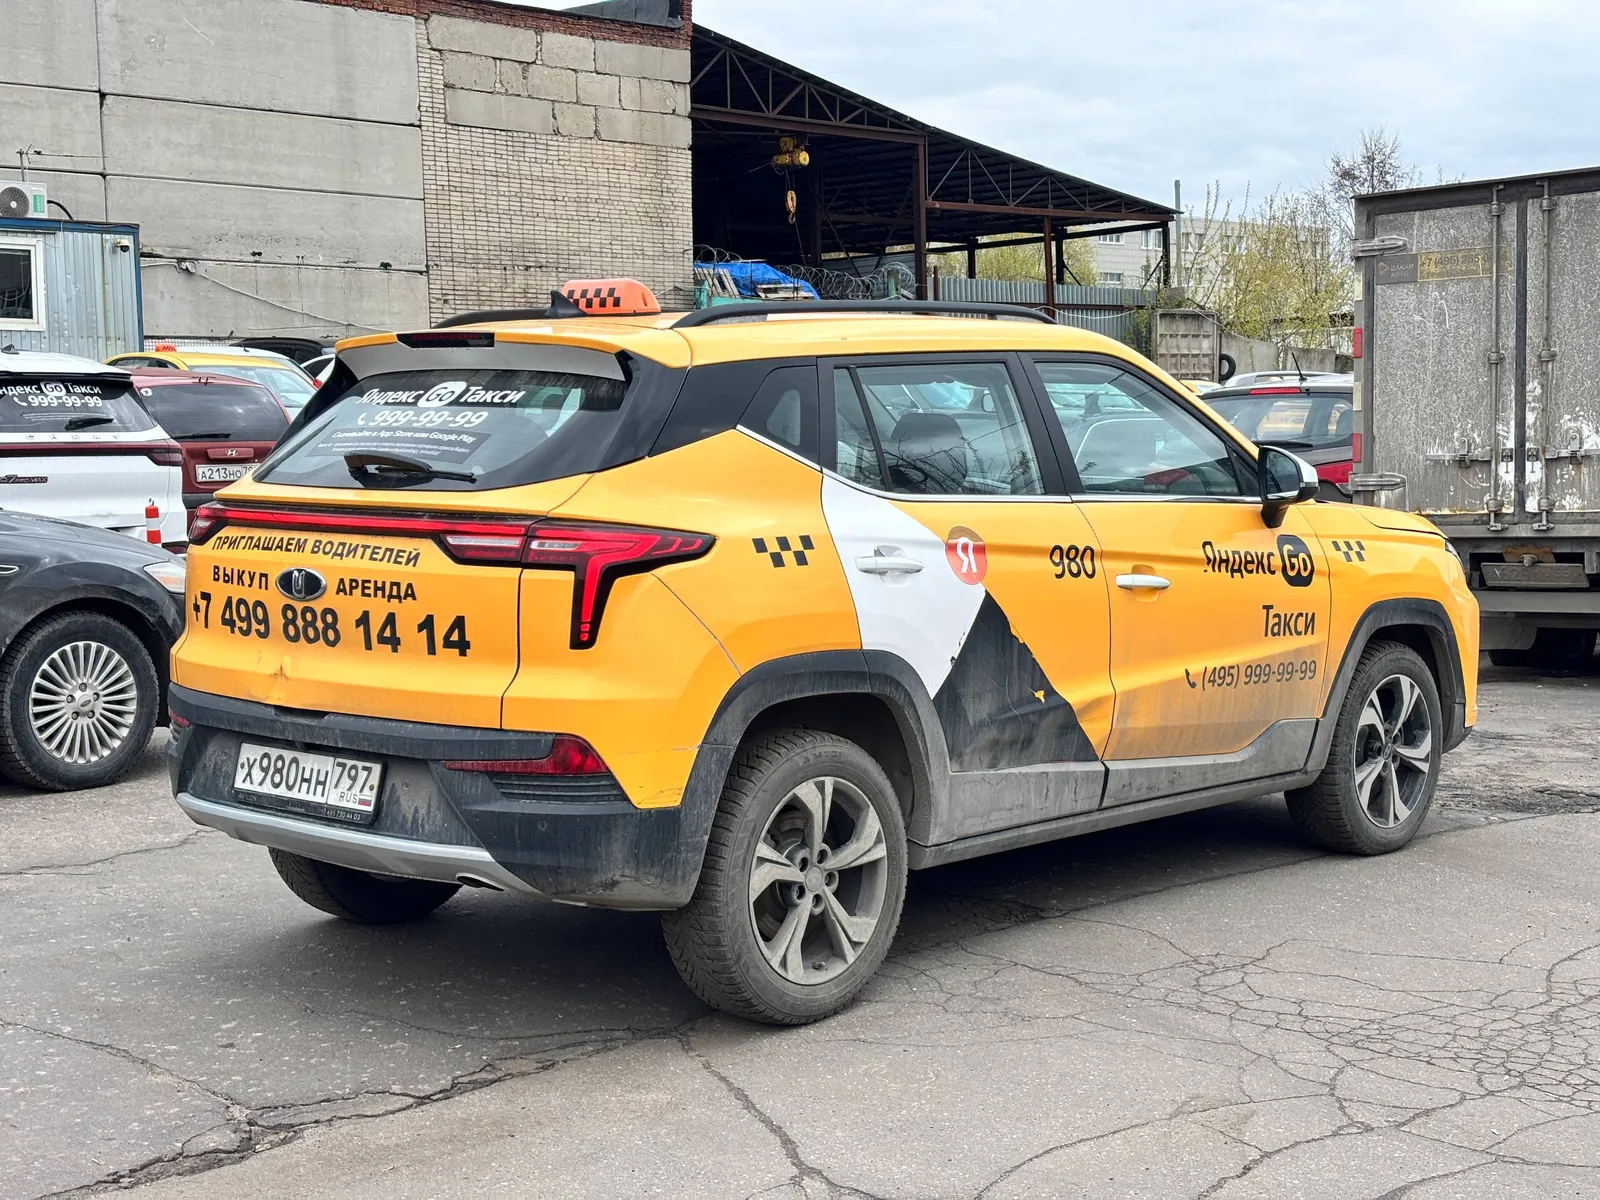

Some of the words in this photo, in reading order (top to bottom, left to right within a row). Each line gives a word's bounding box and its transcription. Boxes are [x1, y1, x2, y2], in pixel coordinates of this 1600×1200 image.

[0, 385, 41, 396] ндекс
[43, 382, 64, 393] Go
[64, 383, 102, 394] Такси
[28, 395, 102, 407] 999-99-99
[356, 388, 425, 405] Яндекс
[420, 384, 457, 404] Go
[459, 386, 526, 404] Такси
[368, 410, 489, 427] 999-99-99
[377, 430, 394, 438] App
[393, 430, 414, 438] Store
[429, 431, 458, 441] Google
[457, 433, 477, 443] Play
[200, 467, 242, 480] А213НО
[212, 535, 308, 553] ПРИГЛАШАЕМ
[310, 538, 421, 568] ВОДИТЕЛЕЙ
[956, 536, 978, 574] Я
[1049, 544, 1096, 579] 980
[1201, 540, 1276, 579] Яндекс
[1281, 541, 1313, 580] Go
[213, 565, 269, 591] ВЫКУП
[335, 577, 417, 604] АРЕНДА
[193, 591, 212, 629] +7
[220, 595, 270, 640] 499
[281, 603, 341, 648] 888
[355, 609, 401, 654] 14
[417, 614, 471, 657] 14
[1261, 604, 1316, 637] Такси
[1201, 664, 1240, 692] (495)
[1243, 659, 1317, 686] 999-99-99
[334, 761, 373, 794] 797
[238, 792, 258, 803] AVLON
[339, 791, 358, 804] RUS
